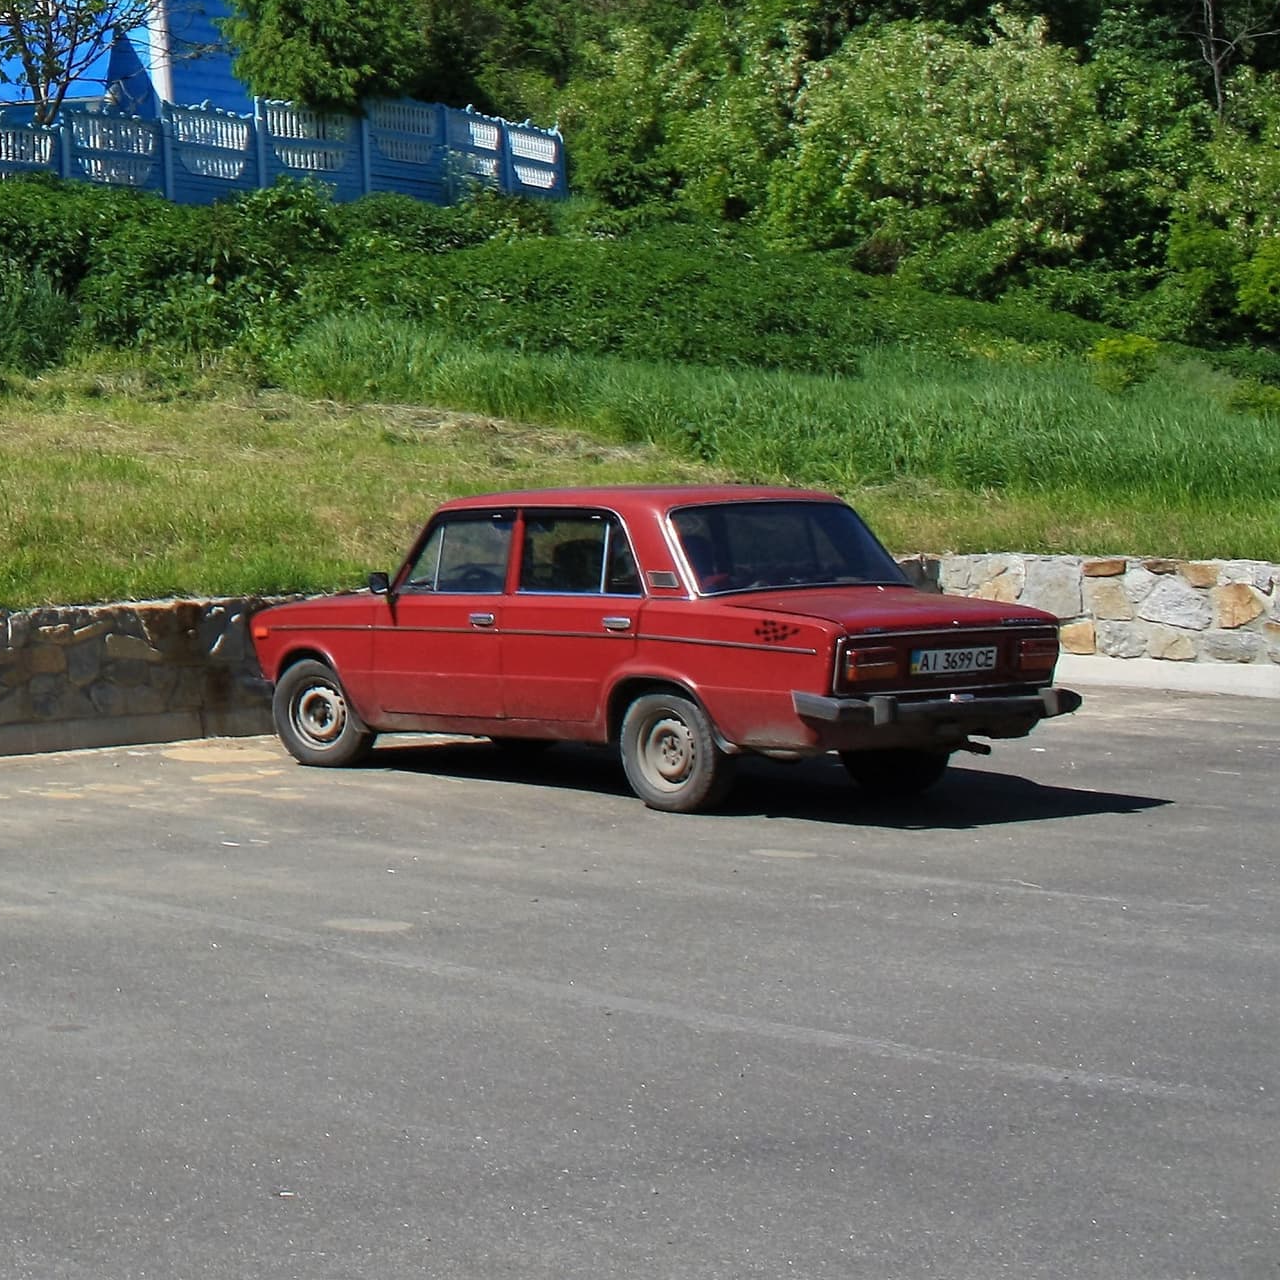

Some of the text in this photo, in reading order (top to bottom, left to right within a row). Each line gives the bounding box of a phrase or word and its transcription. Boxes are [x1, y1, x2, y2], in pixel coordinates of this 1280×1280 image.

[919, 649, 994, 670] AI 3699 CE
